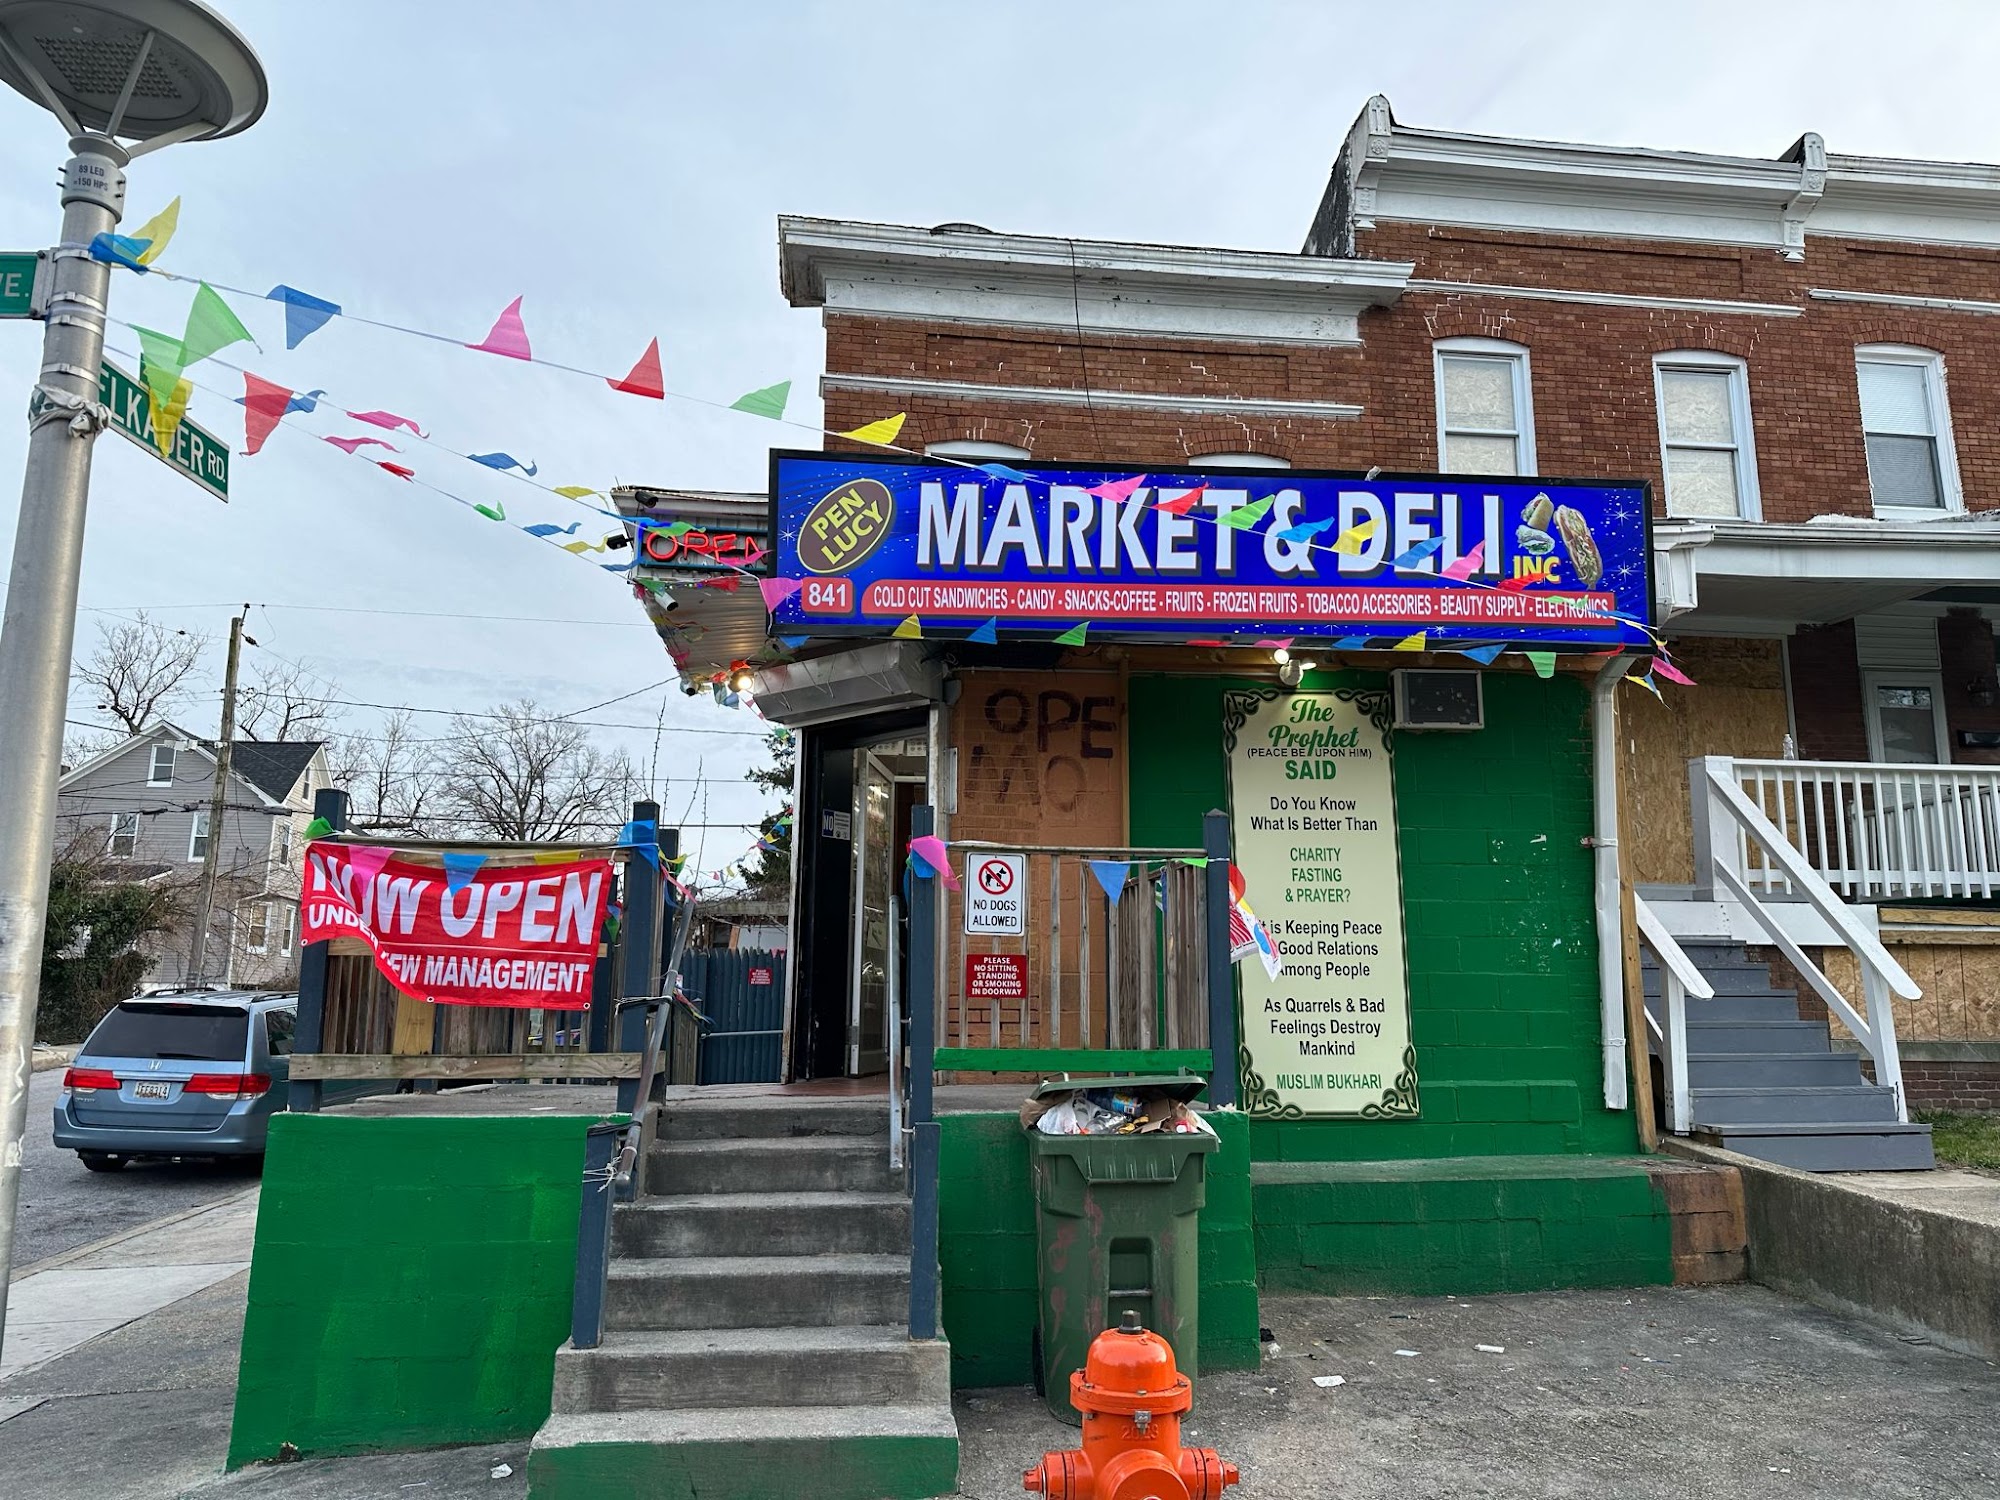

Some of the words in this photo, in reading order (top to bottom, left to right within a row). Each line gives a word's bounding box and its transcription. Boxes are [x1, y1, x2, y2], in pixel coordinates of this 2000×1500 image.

[90, 165, 105, 177] LED
[94, 179, 108, 192] HPS
[0, 272, 29, 297] E.
[208, 449, 226, 484] RD.
[811, 488, 866, 541] PEN
[820, 500, 884, 565] LUCY
[916, 481, 1248, 571] MARKET
[1263, 489, 1324, 575] &
[1338, 490, 1501, 576] DELI
[1513, 554, 1560, 584] INC
[808, 582, 847, 607] 841
[874, 586, 905, 608] COLD
[908, 586, 931, 609] CUT
[933, 587, 1008, 610] SANDWICHES
[1017, 589, 1055, 610] CANDY
[1064, 591, 1156, 612] SNACKS-COFFEE
[1165, 592, 1204, 613] FRUITS
[1213, 594, 1256, 613] FROZEN
[1259, 594, 1298, 614] FRUITS
[1307, 594, 1360, 614] TOBACCO
[1362, 595, 1432, 615] ACCESORIES
[1440, 595, 1484, 616] BEAUTY
[1486, 596, 1526, 617] SUPPLY
[1535, 597, 1608, 619] ELECTRONICS
[1289, 699, 1335, 723] The
[1268, 725, 1359, 757] Prophet
[1247, 748, 1289, 759] (PEACE
[1291, 748, 1305, 757] BE
[1315, 748, 1345, 758] UPON
[1349, 748, 1372, 759] HIM)
[1285, 760, 1337, 780] SAID
[1270, 797, 1288, 811] Do
[1291, 797, 1316, 811] You
[1320, 797, 1357, 811] Know
[1251, 817, 1284, 831] What
[1288, 817, 1299, 831] Is
[1303, 817, 1342, 831] Better
[1345, 817, 1378, 831] Than
[1290, 848, 1341, 862] CHARITY
[1291, 868, 1342, 882] FASTING
[309, 852, 432, 935] NOW
[440, 872, 602, 945] OPEN
[1285, 888, 1294, 903] &
[1297, 888, 1351, 903] PRAYER?
[973, 899, 987, 910] NO
[990, 900, 1017, 911] DOGS
[972, 915, 1017, 927] ALLOWED
[1270, 920, 1282, 934] is
[1285, 920, 1339, 937] Keeping
[1343, 920, 1383, 935] Peace
[1278, 941, 1313, 955] Good
[1317, 941, 1378, 956] Relations
[424, 955, 590, 993] MANAGEMENT
[973, 964, 986, 972] NO
[987, 965, 1019, 973] SITTING,
[976, 972, 1017, 980] STANDING
[1325, 962, 1370, 979] People
[984, 980, 1022, 988] SMOKING
[982, 988, 1022, 996] DOORWAY
[1264, 998, 1281, 1013] As
[1285, 998, 1341, 1013] Quarrels
[1346, 998, 1355, 1012] &
[1360, 998, 1385, 1013] Bad
[1270, 1019, 1326, 1037] Feelings
[1330, 1019, 1381, 1037] Destroy
[1299, 1041, 1355, 1056] Mankind
[1276, 1074, 1324, 1090] MUSLIM
[1327, 1074, 1382, 1090] BUKHARI
